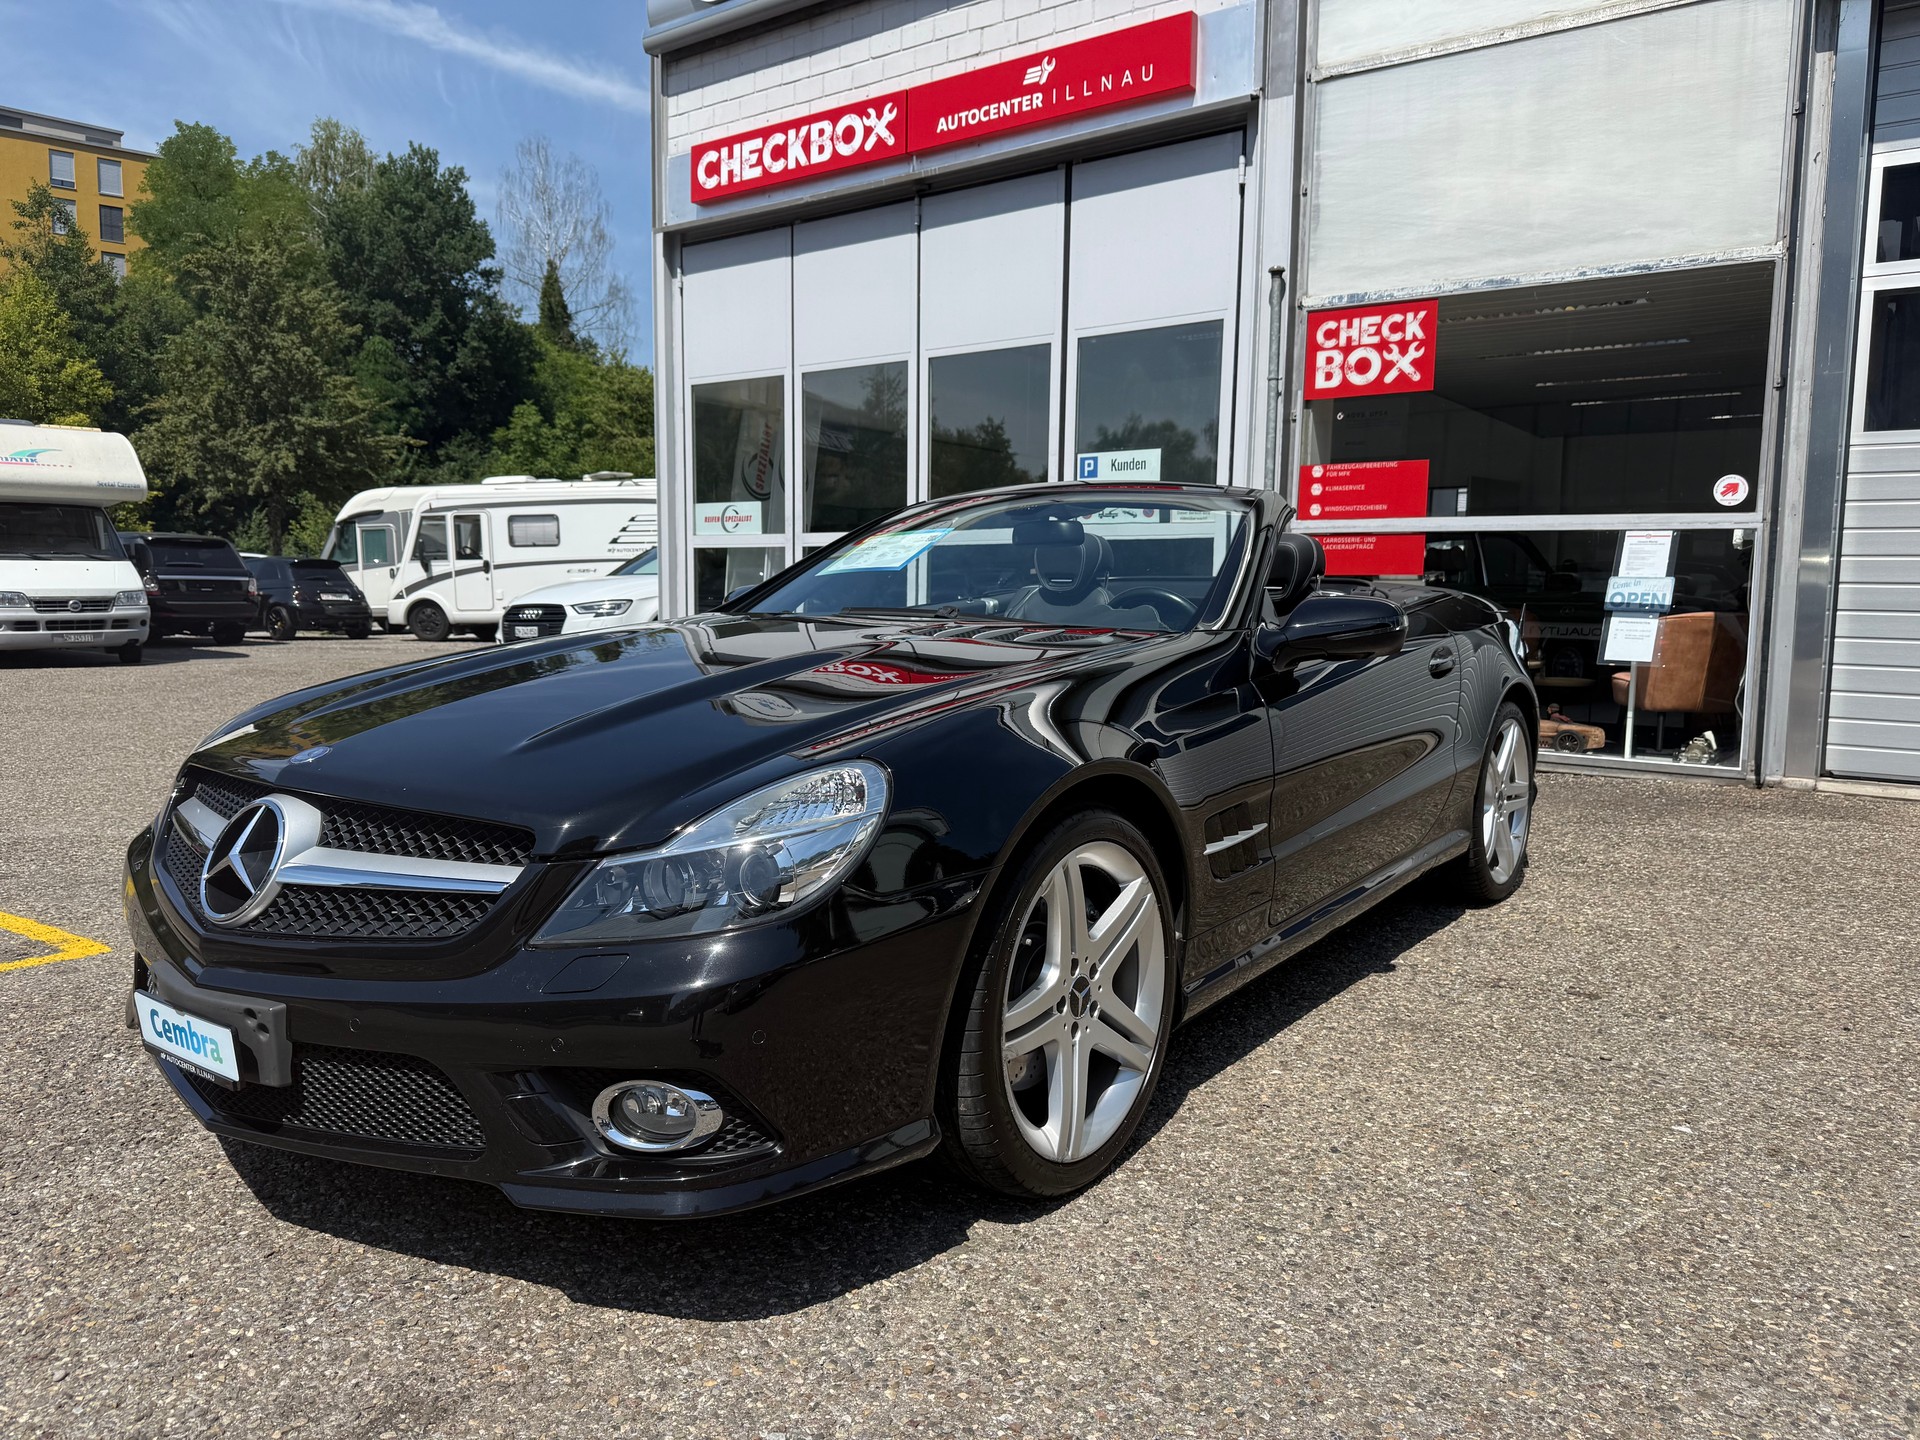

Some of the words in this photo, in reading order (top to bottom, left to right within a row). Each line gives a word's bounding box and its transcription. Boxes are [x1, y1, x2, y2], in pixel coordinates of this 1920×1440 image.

[936, 92, 1043, 133] AUTOCENTER
[1052, 63, 1153, 104] ILLNAU
[697, 102, 898, 189] CHECKBOX
[1316, 310, 1427, 348] CHECK
[1315, 341, 1425, 389] BOX
[1111, 457, 1147, 472] Kunden
[1326, 462, 1398, 471] FAHRZEUGAUFBEREITUNG
[1325, 484, 1366, 492] KLIMASERVICE
[1324, 504, 1388, 512] WINDSCHUTZSCHEIBEN
[725, 515, 752, 523] SPEZIALIST
[1612, 581, 1632, 589] Come
[1609, 591, 1667, 609] OPEN
[150, 1008, 224, 1065] Cembra
[166, 1054, 197, 1073] AUTOCENTER
[196, 1069, 215, 1082] ILLNAU
